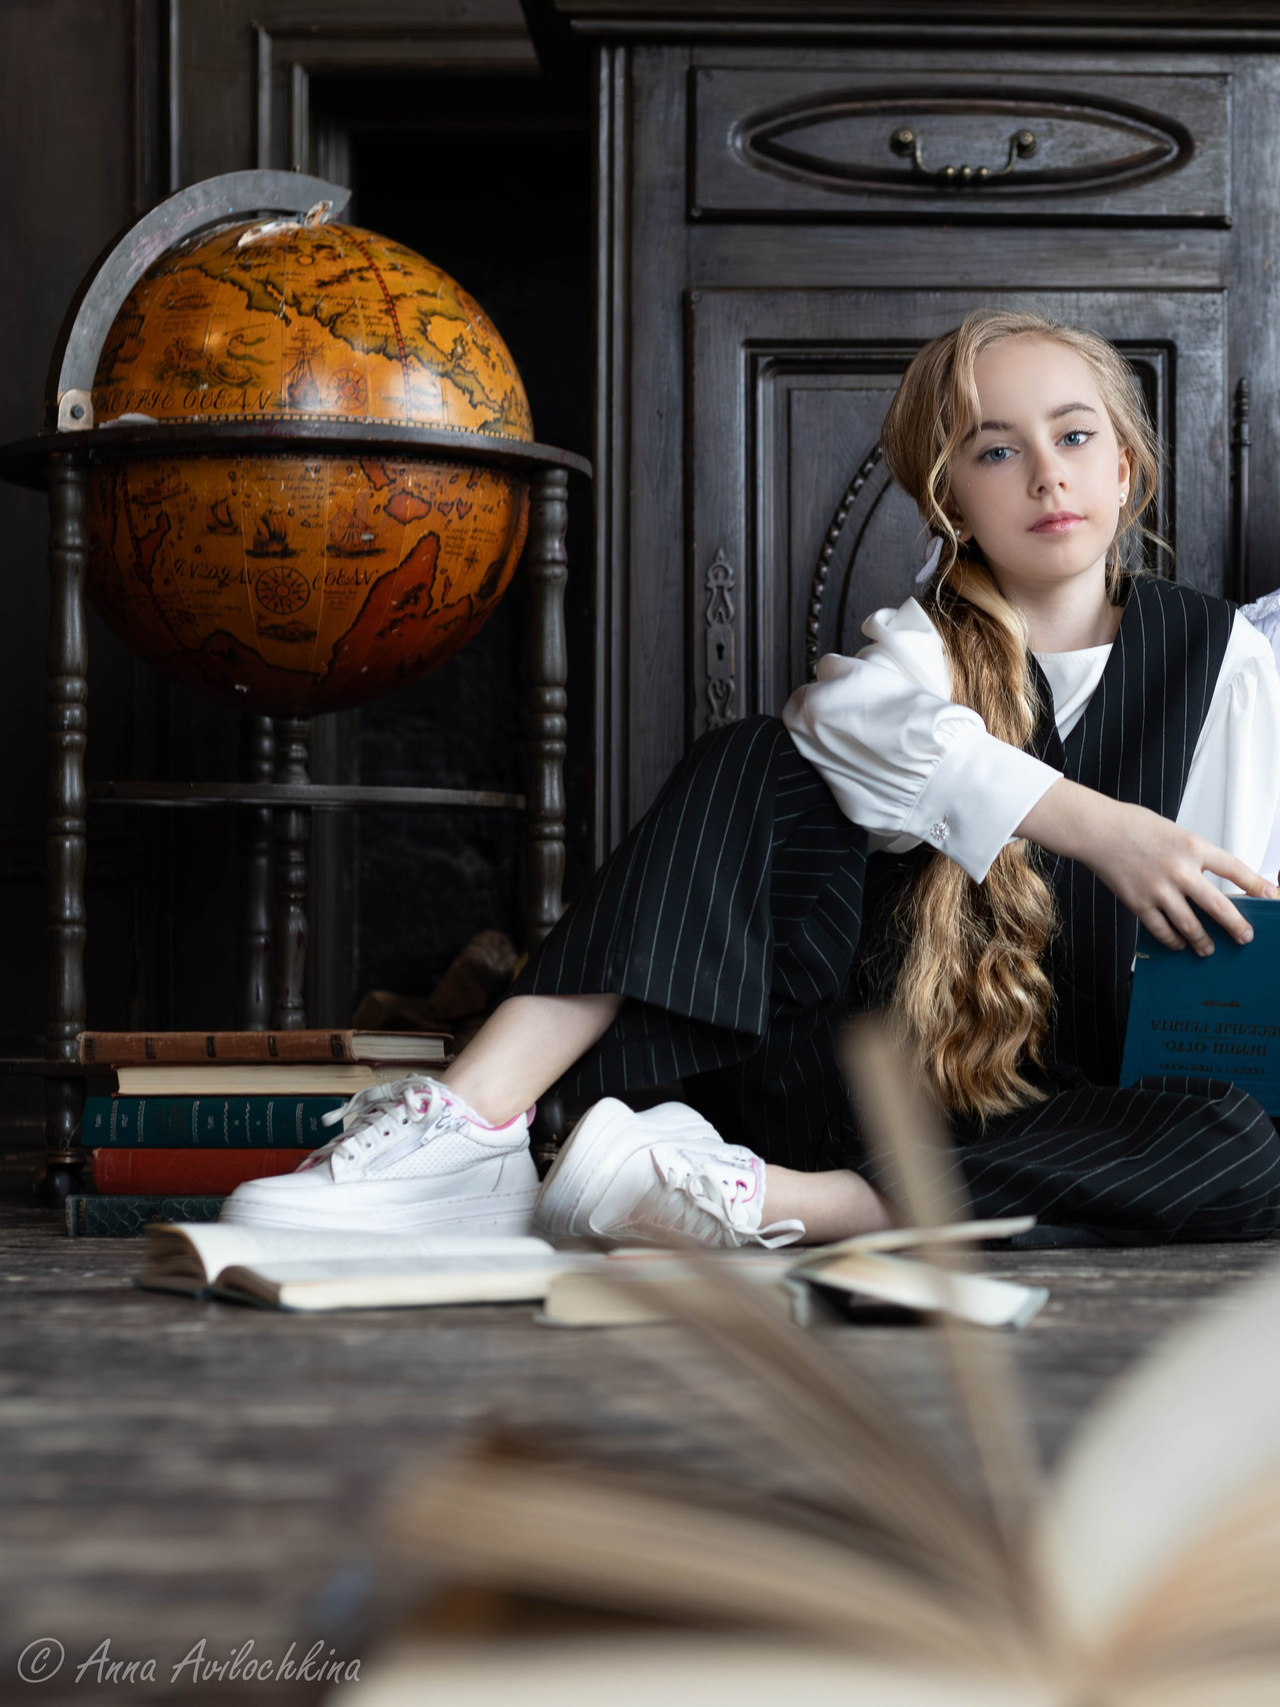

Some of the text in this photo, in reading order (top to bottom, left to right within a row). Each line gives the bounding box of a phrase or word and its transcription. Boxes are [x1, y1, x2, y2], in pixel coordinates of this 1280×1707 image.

[183, 388, 272, 411] OCEAN
[173, 559, 379, 590] INDIAN OCEAN
[1150, 1018, 1210, 1034] РЕБЯТА
[1165, 1040, 1267, 1057] ПРИНЦ ОТТО
